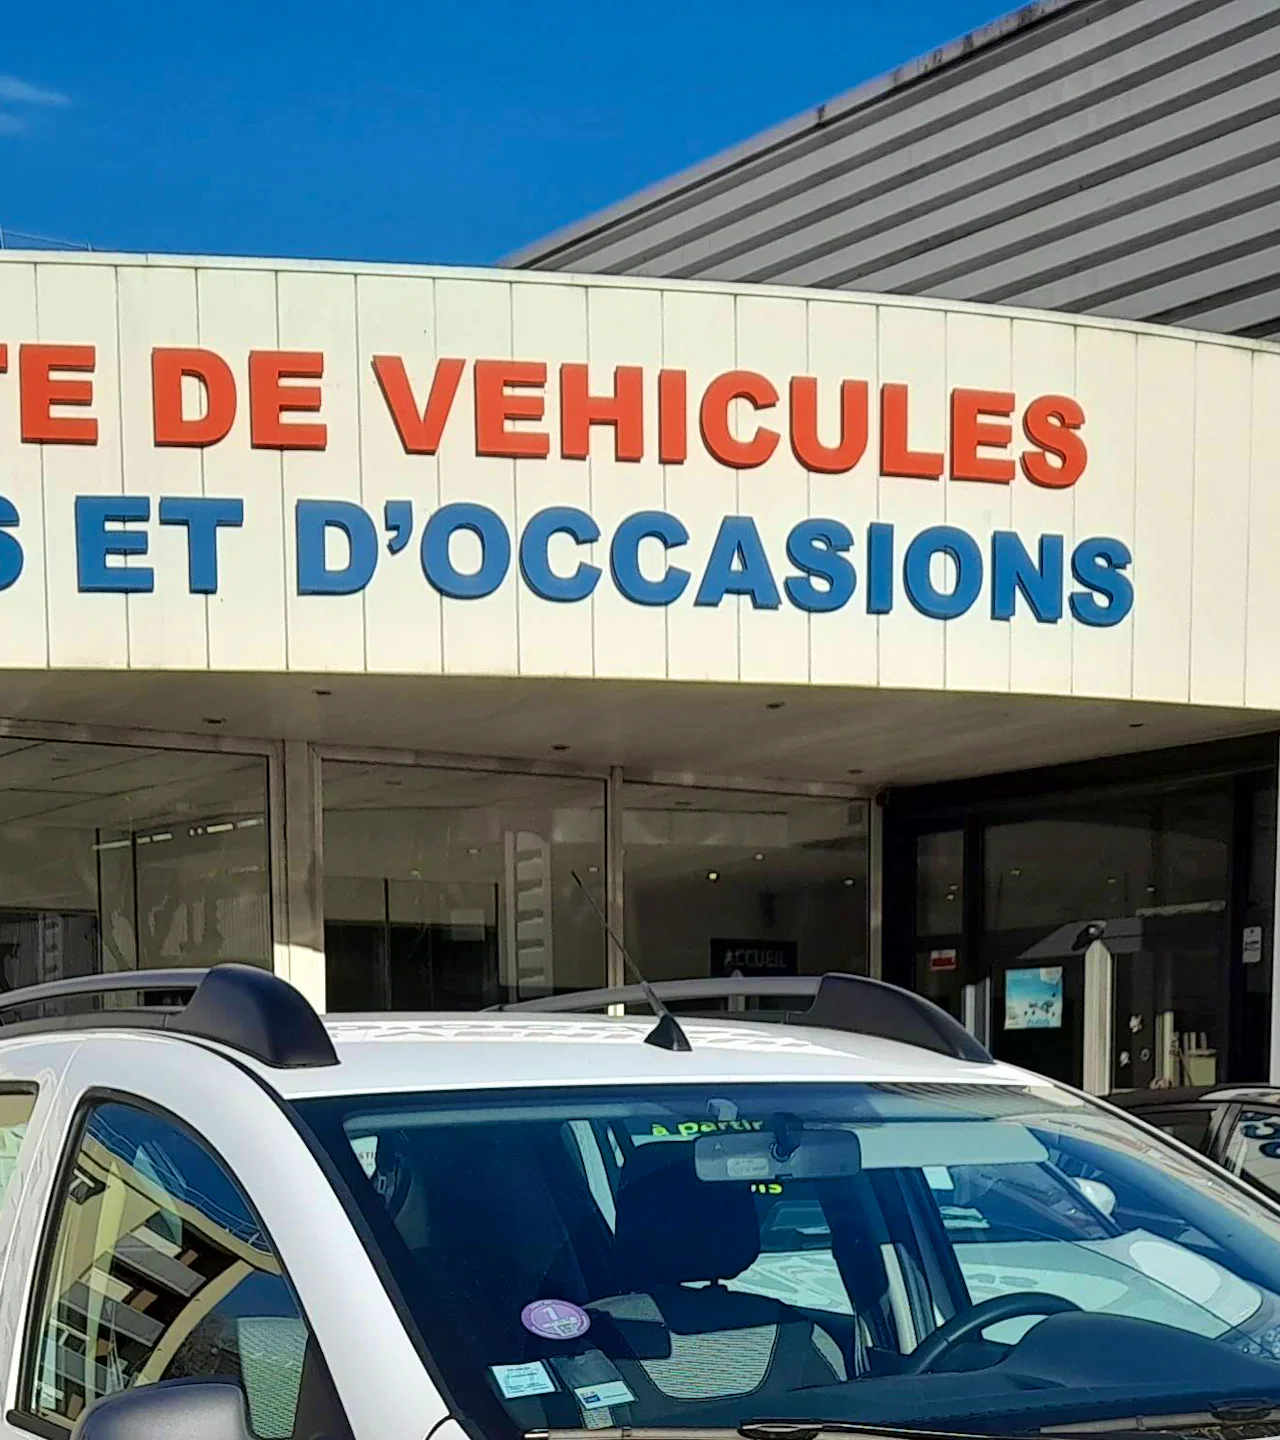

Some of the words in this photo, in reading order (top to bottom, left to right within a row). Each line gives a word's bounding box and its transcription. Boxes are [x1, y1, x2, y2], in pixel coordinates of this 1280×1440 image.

[151, 346, 328, 450] DE
[372, 354, 1088, 489] VEHICULES
[75, 495, 244, 596] ET
[723, 948, 788, 968] ACCUEIL
[677, 1118, 764, 1138] partir
